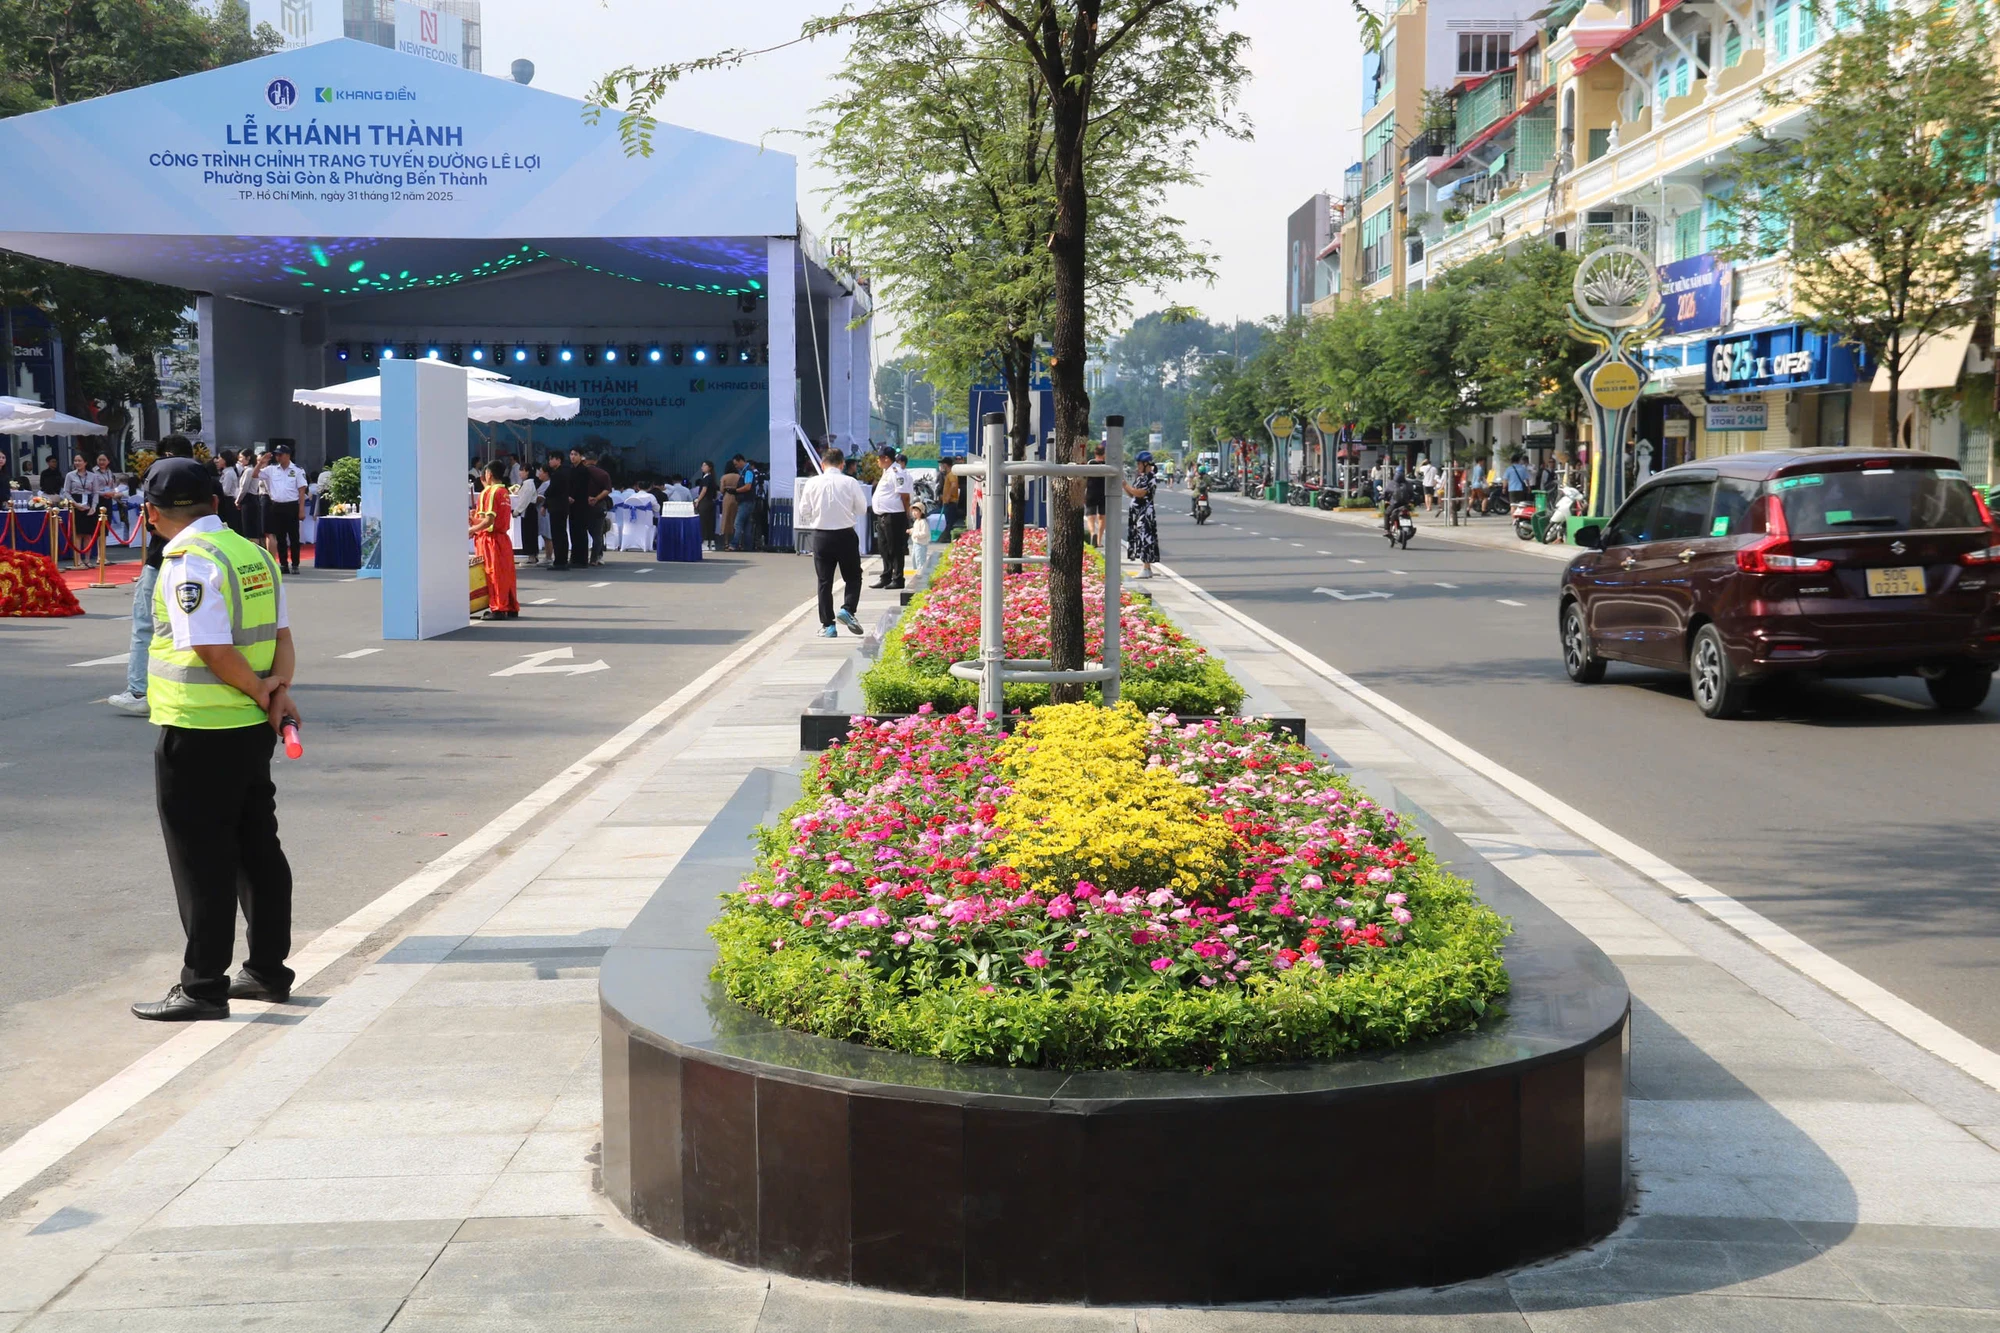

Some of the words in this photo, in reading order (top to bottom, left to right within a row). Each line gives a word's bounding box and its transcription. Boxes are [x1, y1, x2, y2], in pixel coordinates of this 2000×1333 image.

[400, 40, 458, 65] NEWTECONS
[336, 90, 382, 100] KHANG
[384, 86, 416, 100] ĐIỀN
[226, 114, 259, 146] LỄ
[266, 118, 360, 146] KHÁNH
[368, 119, 462, 146] THÀNH
[149, 152, 198, 168] CÔNG
[202, 152, 250, 167] TRÌNH
[254, 150, 305, 168] CHỈNH
[308, 154, 366, 168] TRANG
[370, 150, 424, 168] TUYẾN
[428, 153, 489, 169] ĐƯỜNG
[492, 152, 511, 169] LÊ
[514, 155, 540, 172] LỢI
[204, 171, 263, 188] Phường
[266, 171, 290, 185] Sài
[294, 171, 326, 185] Gòn
[330, 172, 340, 185] &
[344, 171, 402, 188] Phường
[406, 170, 436, 186] Bến
[439, 172, 488, 186] Thành
[238, 191, 254, 201] TP.
[256, 190, 270, 200] Hồ
[272, 190, 290, 200] Chí
[291, 190, 317, 202] Minh,
[320, 192, 346, 204] ngày
[348, 191, 358, 201] 31
[360, 190, 389, 204] tháng
[390, 191, 401, 202] 12
[403, 192, 424, 202] năm
[426, 191, 454, 202] 2025
[1712, 340, 1754, 383] GS25
[580, 377, 638, 393] THÀNH
[1711, 418, 1736, 426] STORE
[1738, 414, 1763, 425] 24H
[1884, 568, 1907, 581] 50G
[1874, 582, 1920, 594] 023.74
